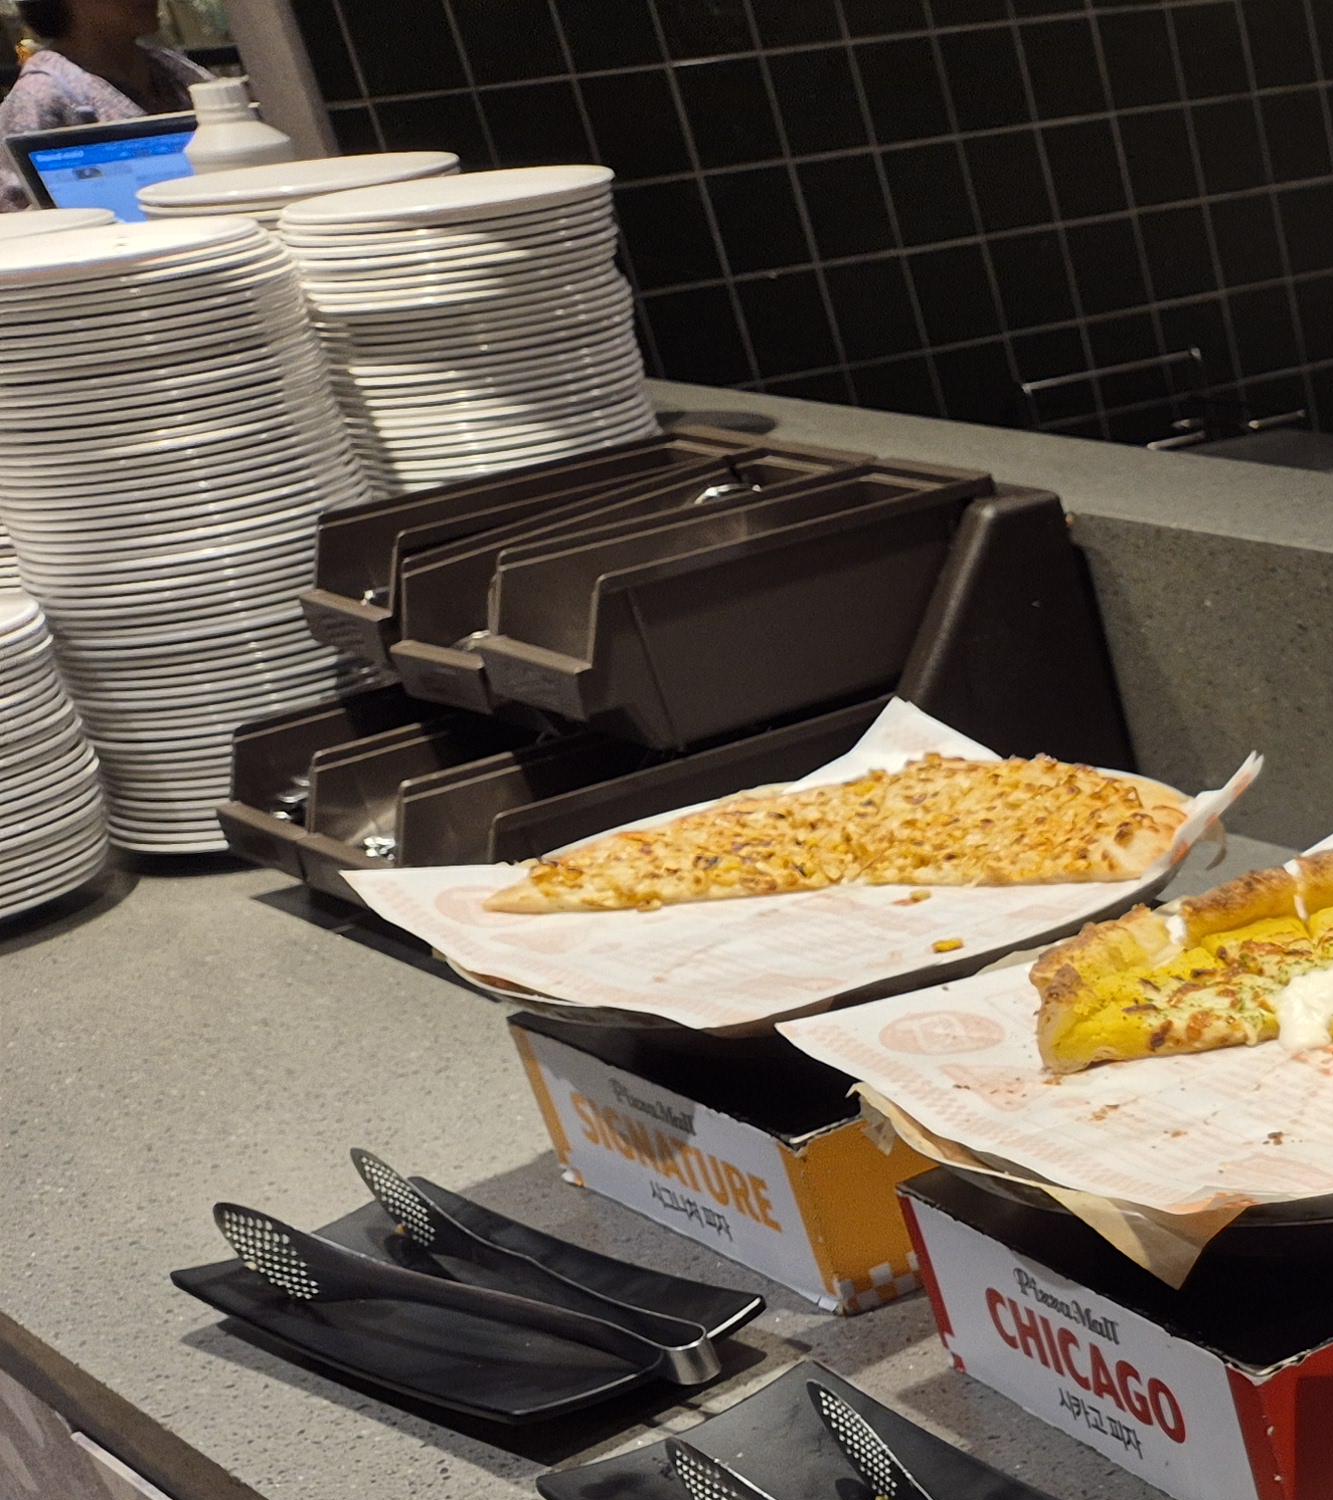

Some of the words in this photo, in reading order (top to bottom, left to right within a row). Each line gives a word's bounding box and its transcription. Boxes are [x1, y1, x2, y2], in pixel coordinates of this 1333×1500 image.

[570, 1091, 783, 1233] SIGNATURE
[985, 1287, 1186, 1443] CHICAGO
[1058, 1387, 1108, 1435] 시카고
[1106, 1415, 1143, 1460] 피자
